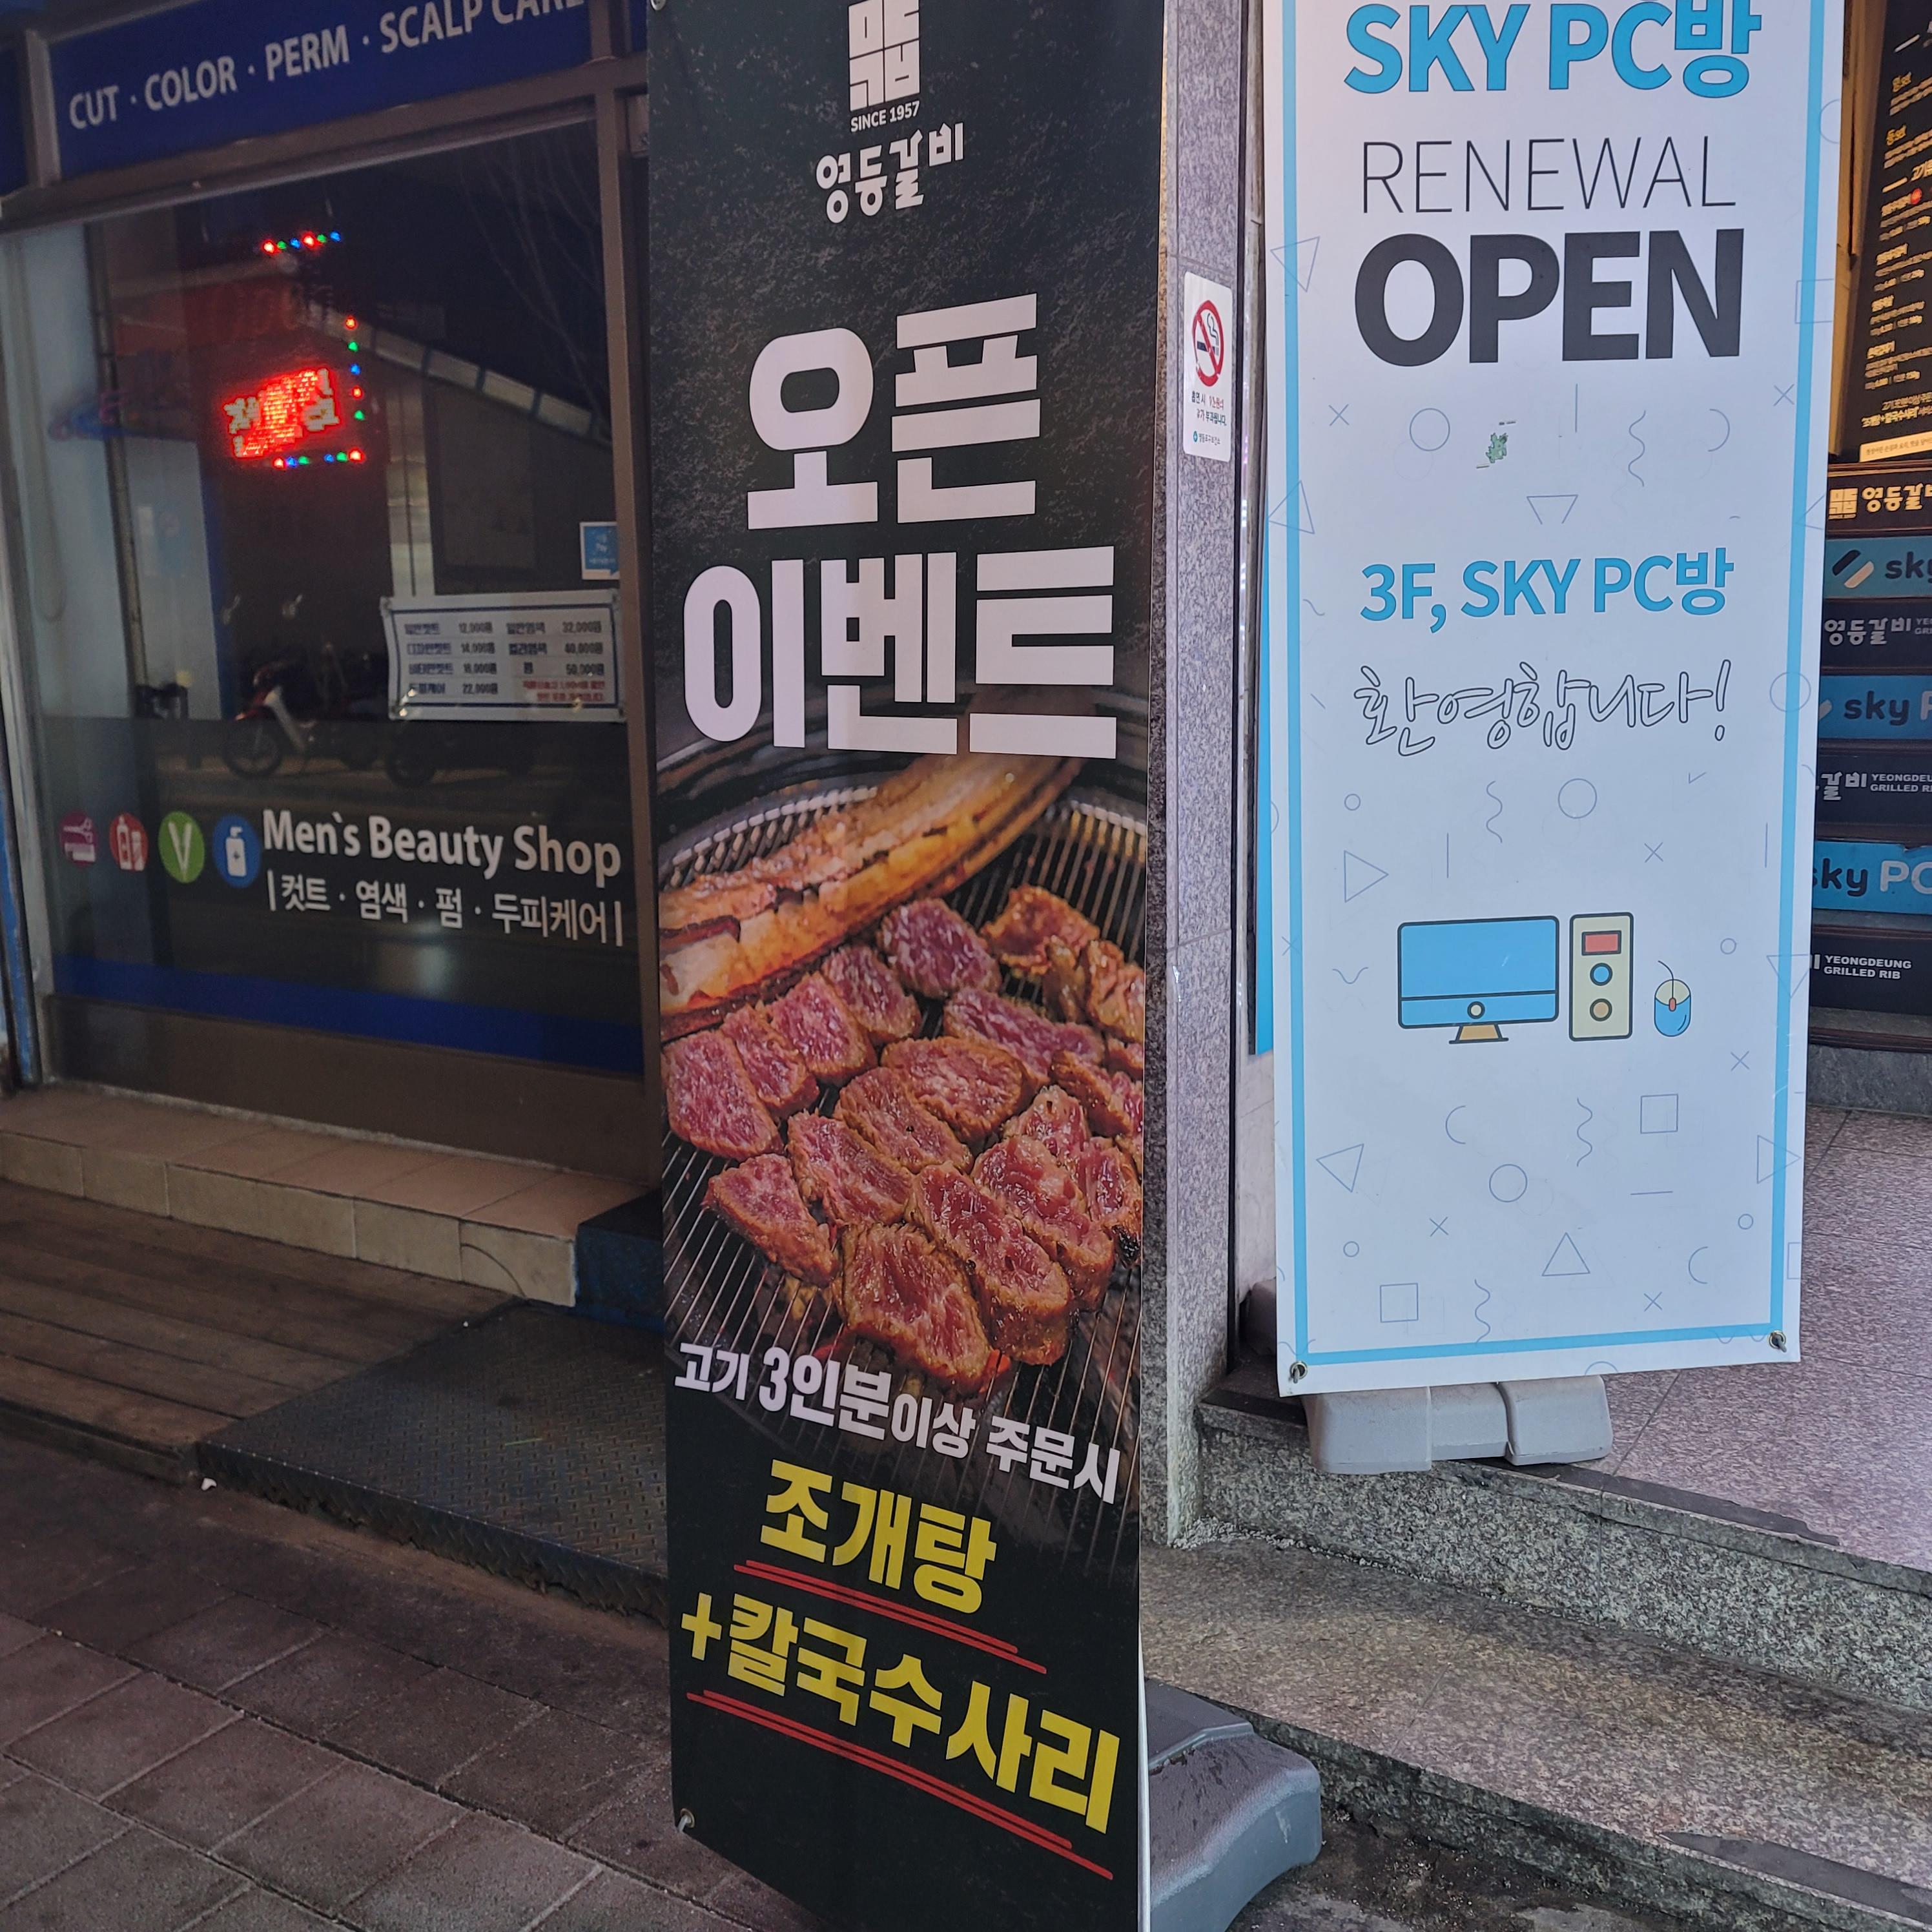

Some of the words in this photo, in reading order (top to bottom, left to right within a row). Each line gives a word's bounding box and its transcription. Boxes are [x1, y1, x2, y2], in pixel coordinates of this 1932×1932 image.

[70, 85, 119, 129] CUT
[145, 56, 238, 111] COLOR
[265, 25, 349, 81] PERM
[380, 0, 483, 53] SCALP
[492, 0, 584, 24] CA
[1344, 4, 1531, 94] SKY
[1548, 0, 1762, 98] PC방
[850, 109, 887, 132] SINCE
[889, 100, 920, 123] 1957
[816, 122, 963, 223] 영등갈비
[1362, 136, 1736, 214] RENEWAL
[1355, 229, 1744, 367] OPEN
[747, 293, 1041, 529] 오픈
[1360, 562, 1447, 633] 3F,
[1461, 559, 1581, 618] SKY
[1594, 547, 1735, 616] PC방
[1885, 551, 1932, 584] sk
[683, 546, 1117, 759] 이벤트
[1824, 617, 1911, 645] 영등갈비
[1353, 659, 1731, 757] 환영합니다!
[1844, 690, 1910, 726] sky
[1816, 772, 1867, 801] 갈비
[1870, 783, 1918, 792] GRILLED
[369, 815, 504, 879] Beauty
[513, 825, 621, 888] Shop
[281, 874, 331, 911] 컷트
[356, 879, 408, 923] 염색
[436, 887, 463, 929] 펌
[492, 893, 607, 943] 두피케어
[1824, 966, 1876, 978] GRILLED
[1878, 970, 1900, 980] RIB
[1825, 955, 1912, 969] YEONGDEUNG
[674, 1342, 748, 1401] 고기
[758, 1345, 977, 1459] 3인분이상
[985, 1415, 1120, 1505] 주문시
[759, 1459, 997, 1614] 조개탕
[680, 1592, 1120, 1834] +칼국수사리
